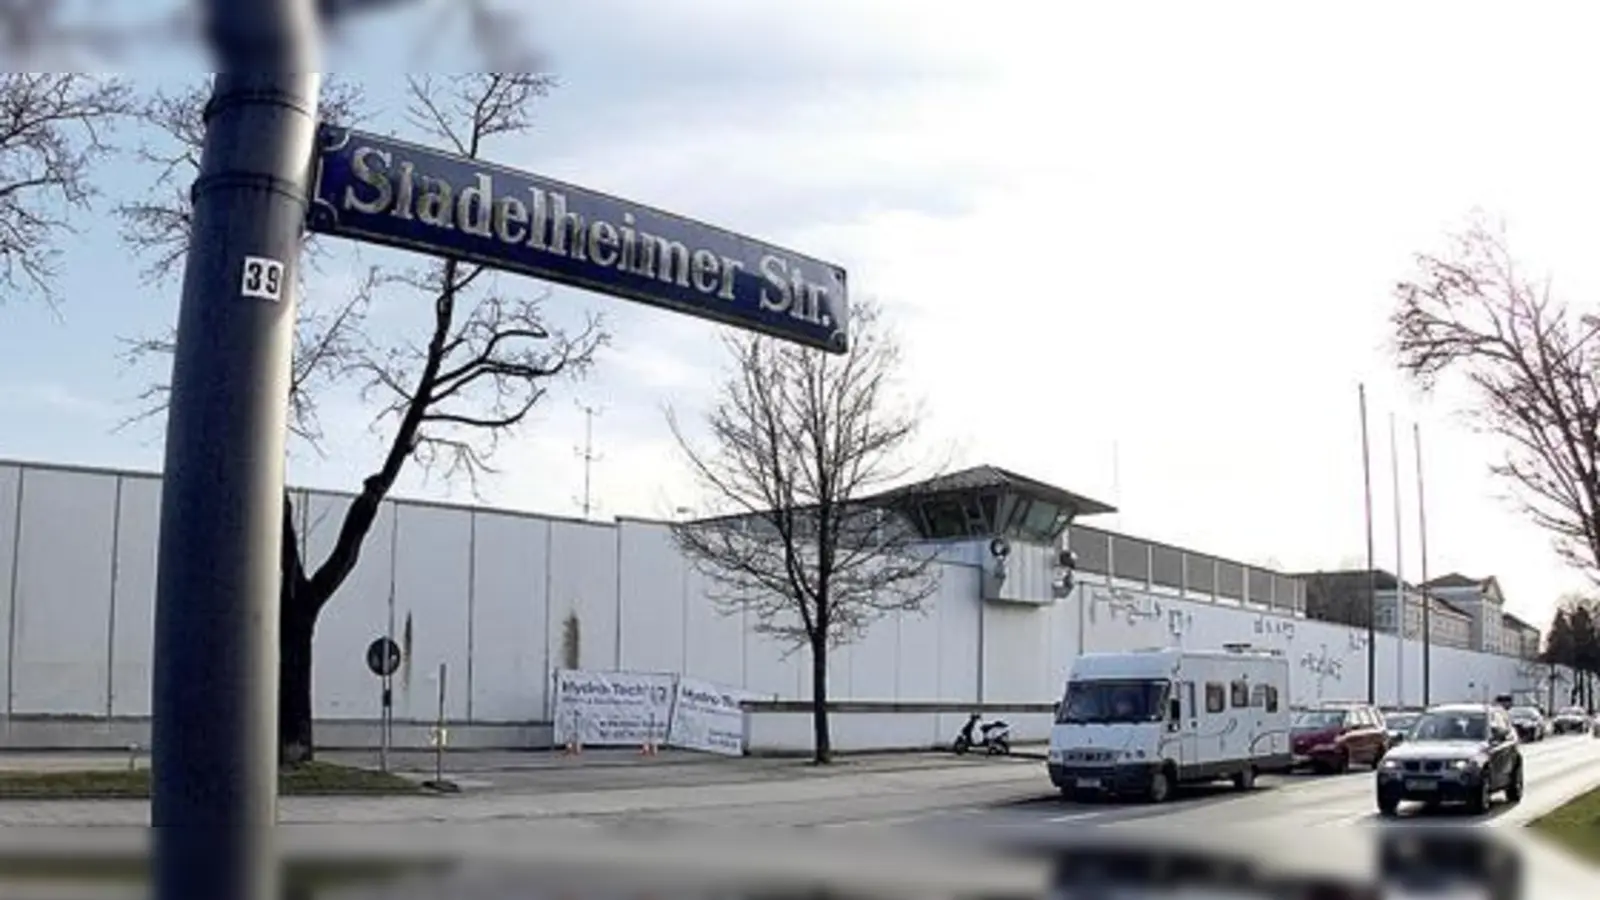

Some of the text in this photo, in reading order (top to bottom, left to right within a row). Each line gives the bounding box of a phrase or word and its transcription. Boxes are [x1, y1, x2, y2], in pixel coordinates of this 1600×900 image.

[247, 262, 280, 294] 39
[344, 146, 831, 327] Stadelheimer Str.
